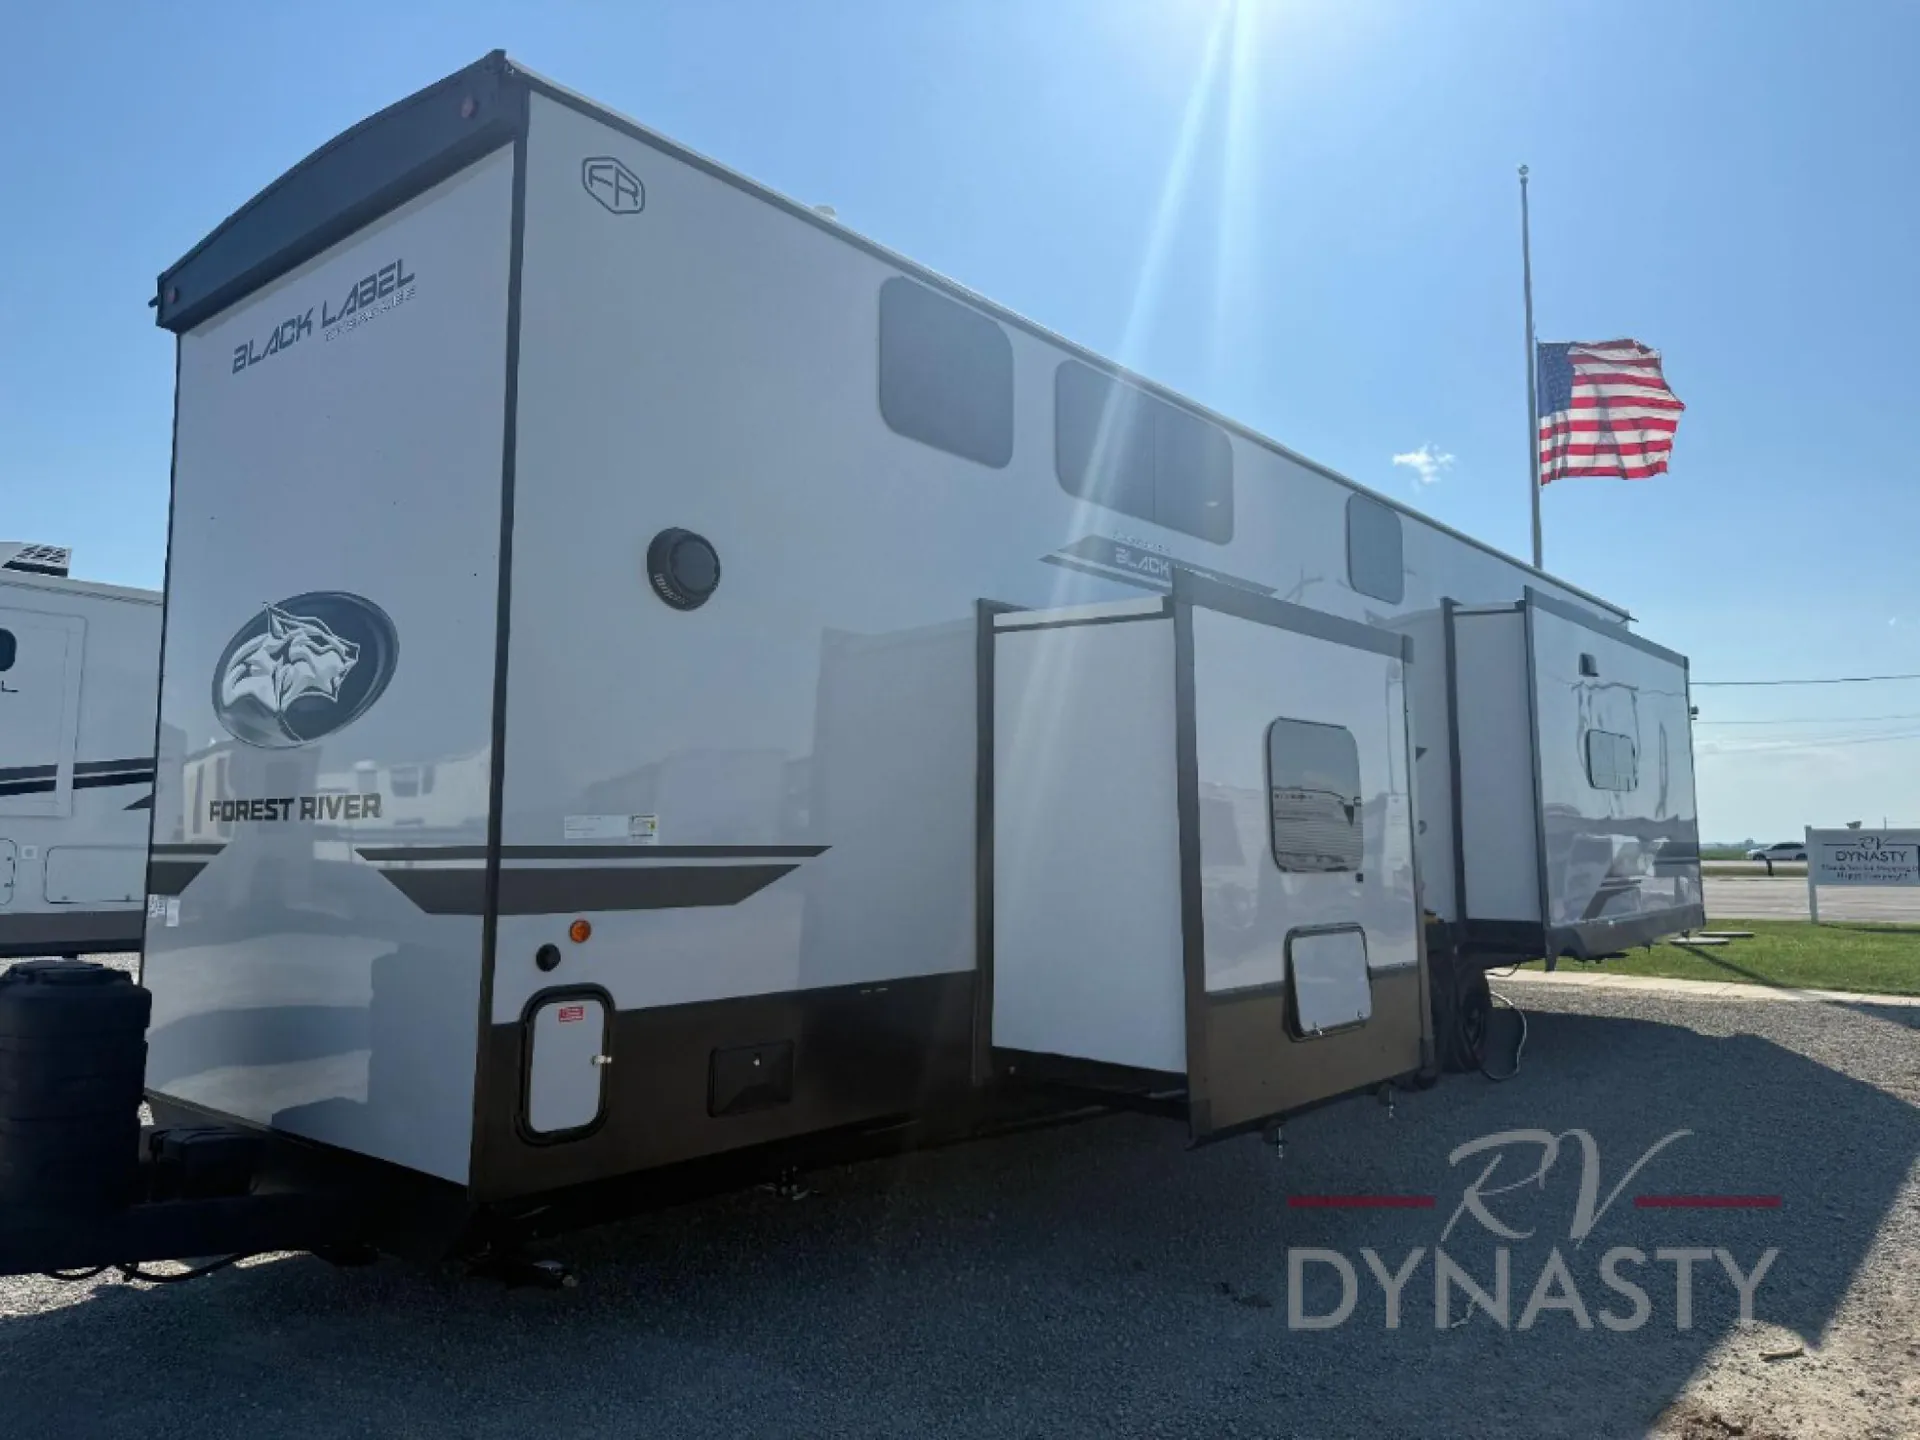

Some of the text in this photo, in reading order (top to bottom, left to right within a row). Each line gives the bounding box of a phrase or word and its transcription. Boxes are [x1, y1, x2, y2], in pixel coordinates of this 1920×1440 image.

[232, 306, 314, 375] BLACK
[321, 258, 416, 328] LABEL
[209, 792, 383, 823] FOREST RIVER
[1835, 850, 1908, 862] DYNASTY
